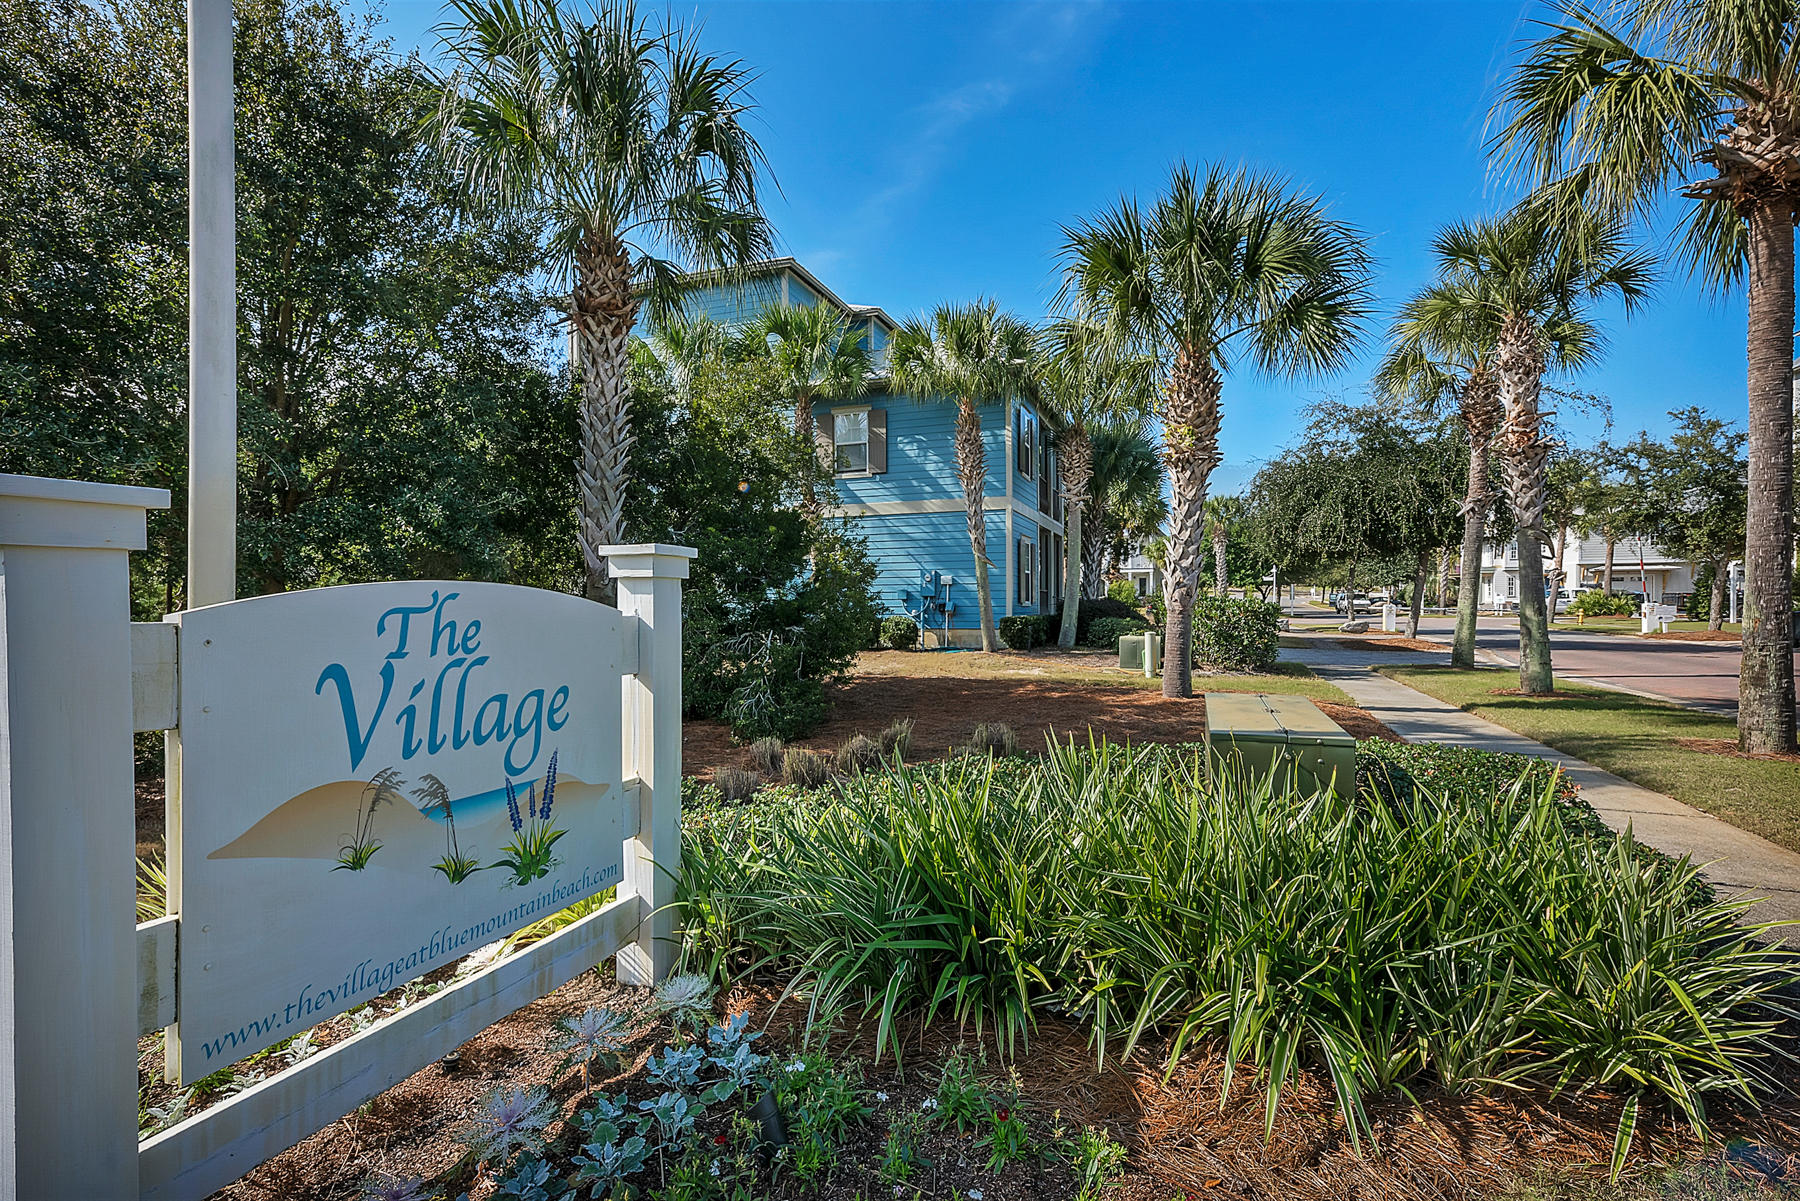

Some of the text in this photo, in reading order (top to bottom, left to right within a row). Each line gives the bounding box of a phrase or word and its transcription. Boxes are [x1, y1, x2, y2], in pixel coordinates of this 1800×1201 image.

[376, 589, 483, 660] The
[315, 655, 570, 777] Village
[201, 862, 618, 1061] www.thevillageatbluemountainbeach.com
